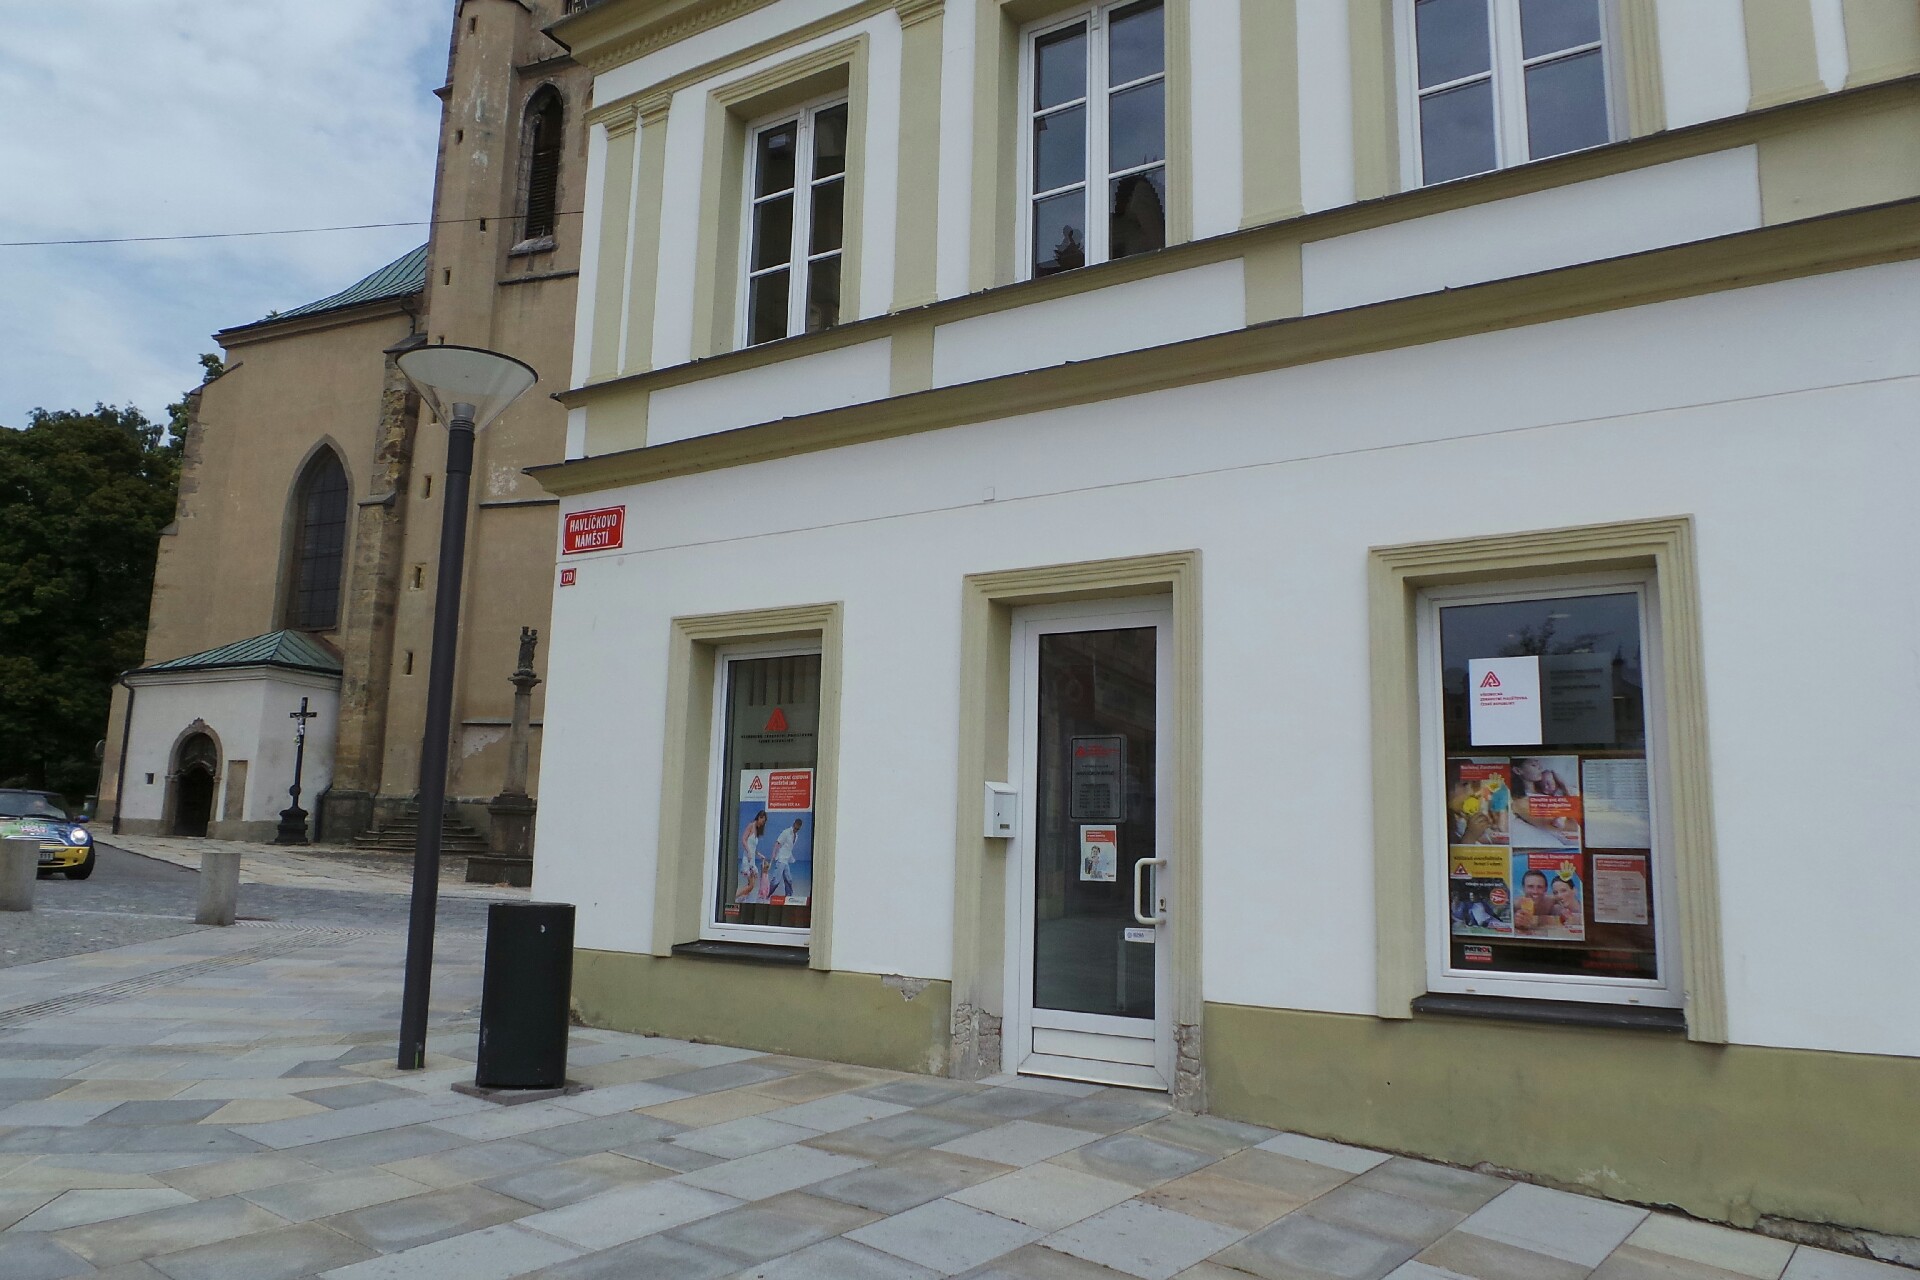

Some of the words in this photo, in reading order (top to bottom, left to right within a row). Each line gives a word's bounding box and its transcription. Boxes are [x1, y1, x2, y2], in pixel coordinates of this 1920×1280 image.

[569, 514, 617, 533] HAVLÍČKOVO
[575, 529, 610, 548] NÁMĚSTÍ
[563, 571, 573, 582] 170
